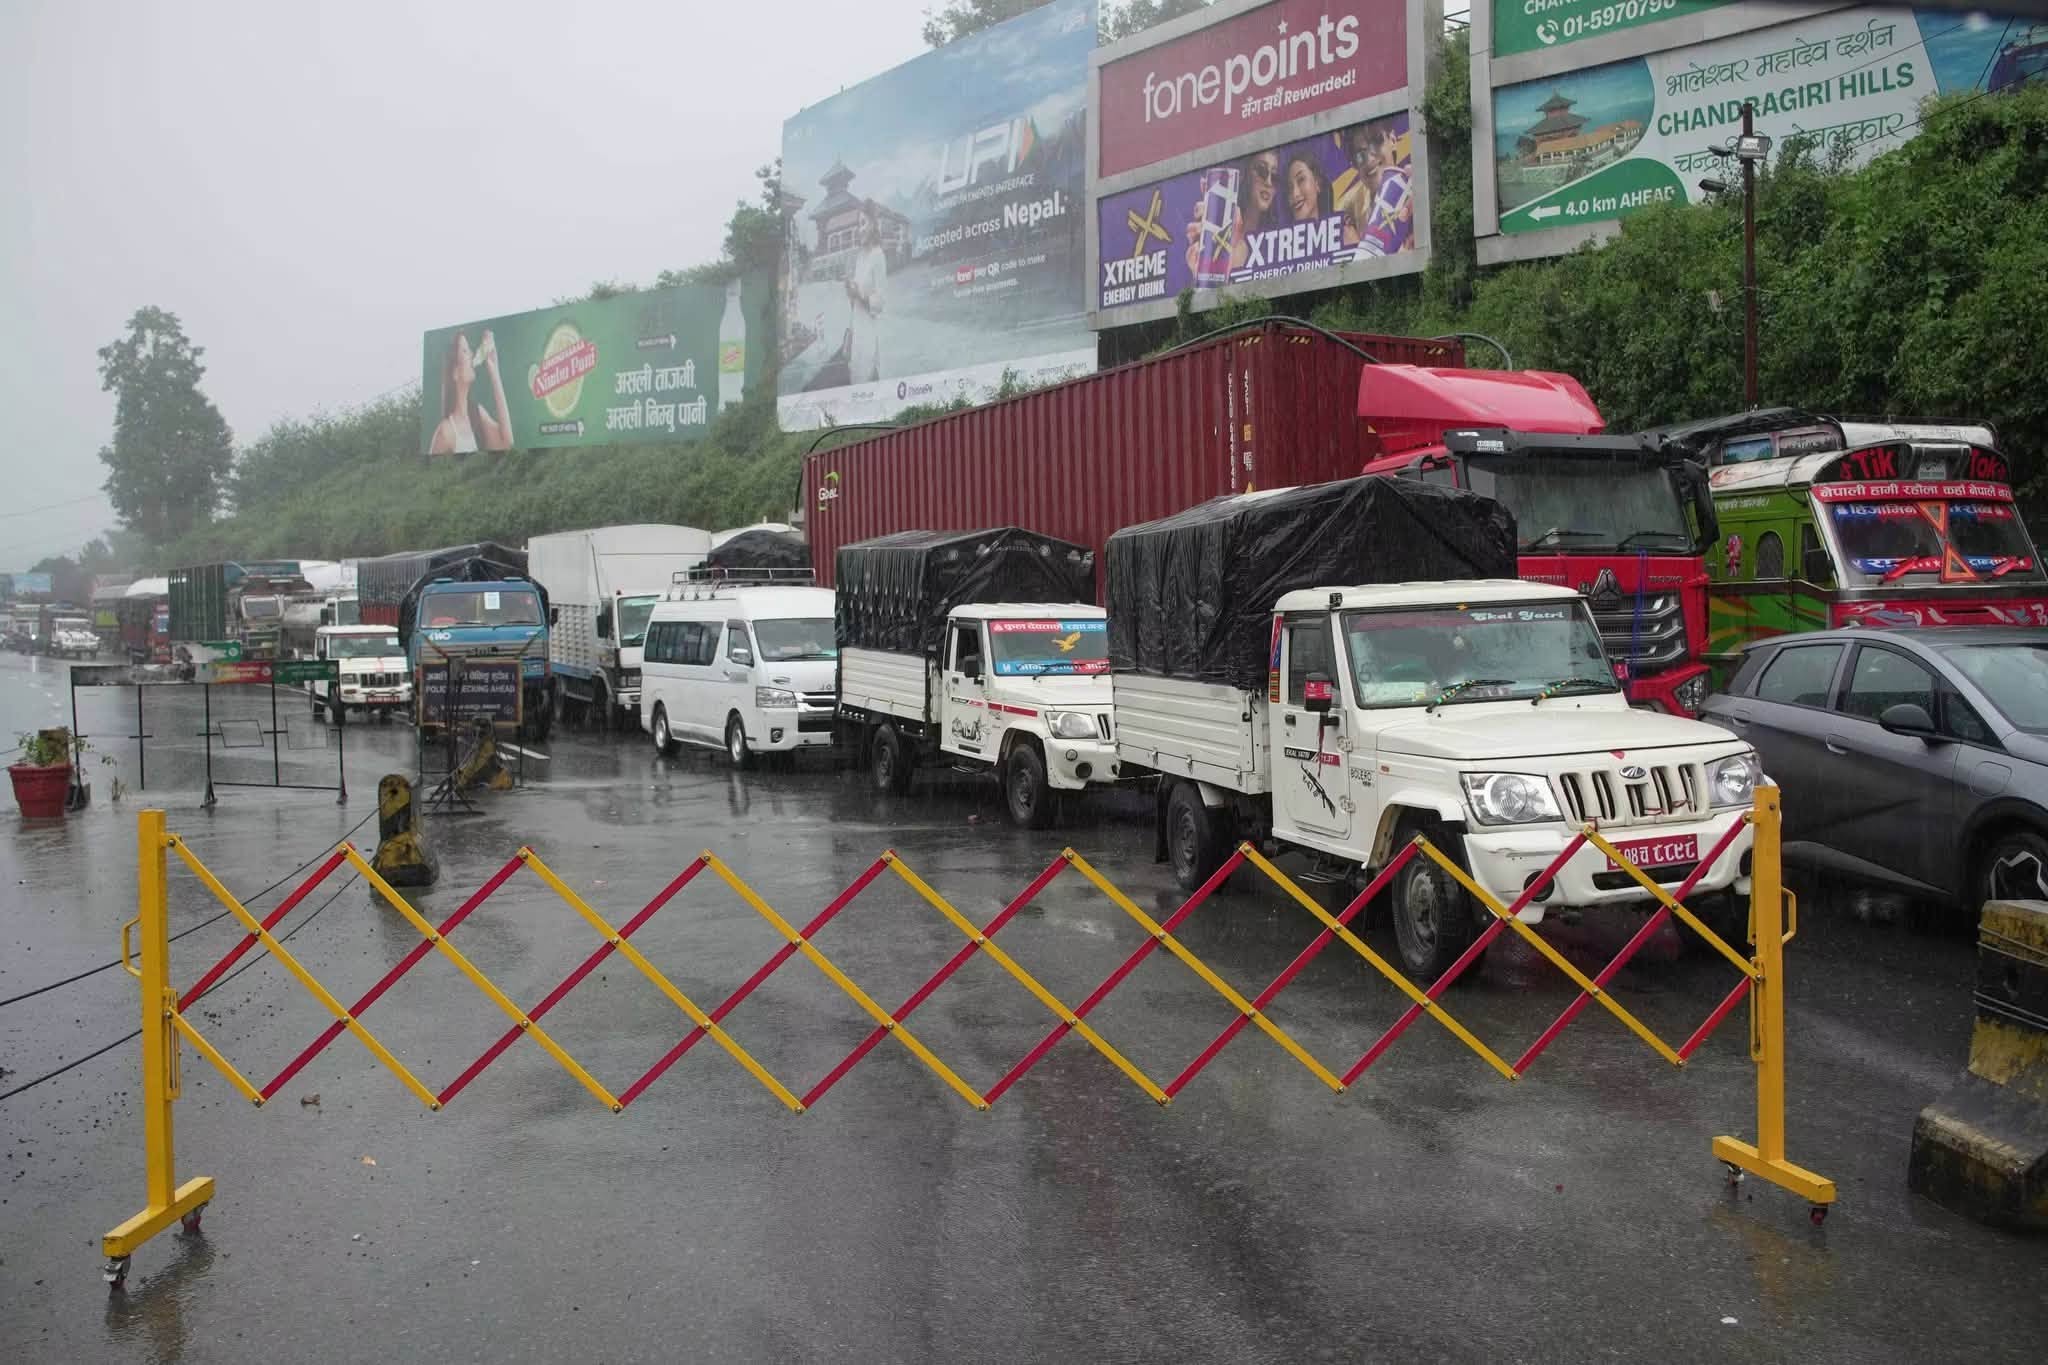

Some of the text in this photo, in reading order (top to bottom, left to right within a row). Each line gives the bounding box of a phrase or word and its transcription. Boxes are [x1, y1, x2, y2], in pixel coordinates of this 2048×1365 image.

[1666, 19, 1896, 97] भालेश्वर महादेव दर्शन
[1284, 68, 1357, 105] Rewarded!
[1839, 62, 1914, 100] HILLS
[938, 118, 1021, 195] UPI
[1566, 199, 1588, 216] 4.0
[1593, 196, 1616, 213] km
[965, 217, 1001, 238] across
[1246, 215, 1342, 268] XTREME
[1104, 250, 1167, 287] XTREME
[1298, 258, 1330, 274] DRINK
[1103, 279, 1165, 306] ENERGY DRINK
[615, 363, 651, 394] असली
[606, 400, 643, 431] असली
[678, 395, 708, 425] पानी
[1851, 447, 1898, 480] Tik
[1820, 483, 1866, 498] नेपाली
